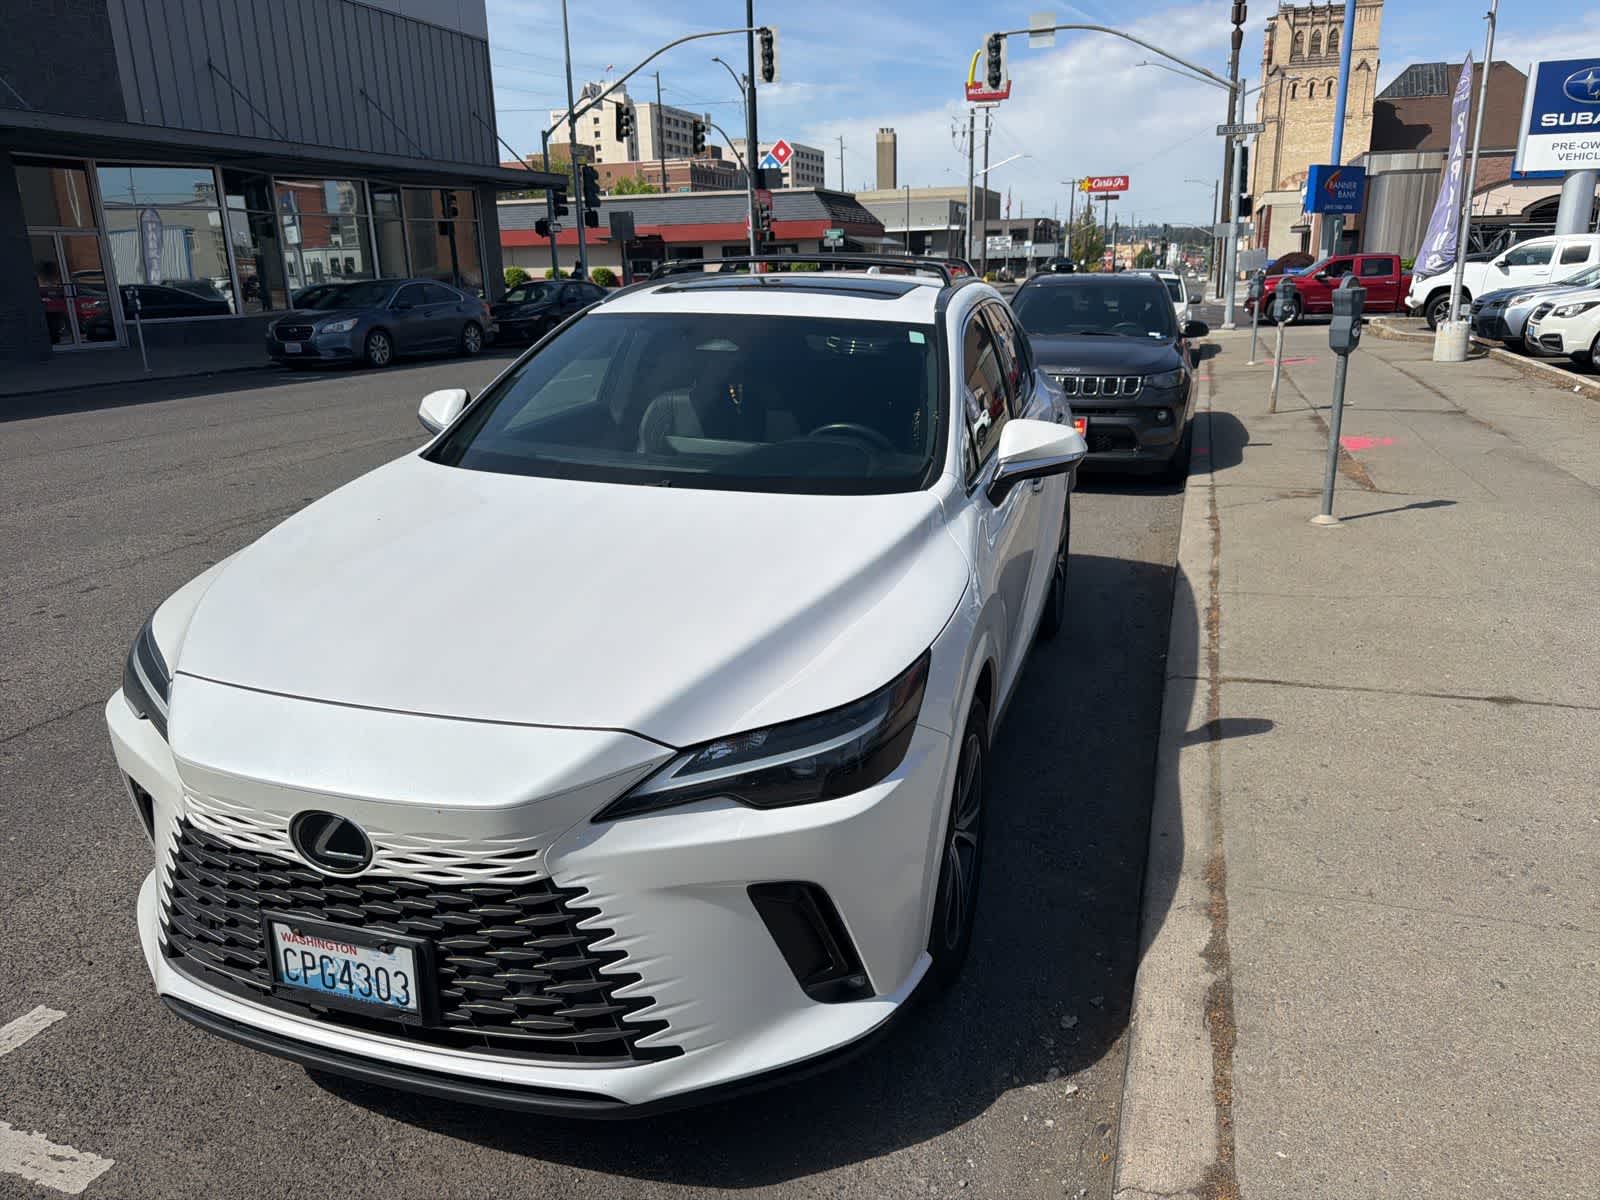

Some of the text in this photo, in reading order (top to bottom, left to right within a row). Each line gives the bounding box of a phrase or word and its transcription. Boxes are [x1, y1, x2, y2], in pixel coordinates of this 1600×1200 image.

[1222, 124, 1260, 133] STEVENS
[1337, 191, 1357, 199] BANK
[280, 932, 358, 956] WASHINGTON
[282, 947, 410, 1006] CPG4303
